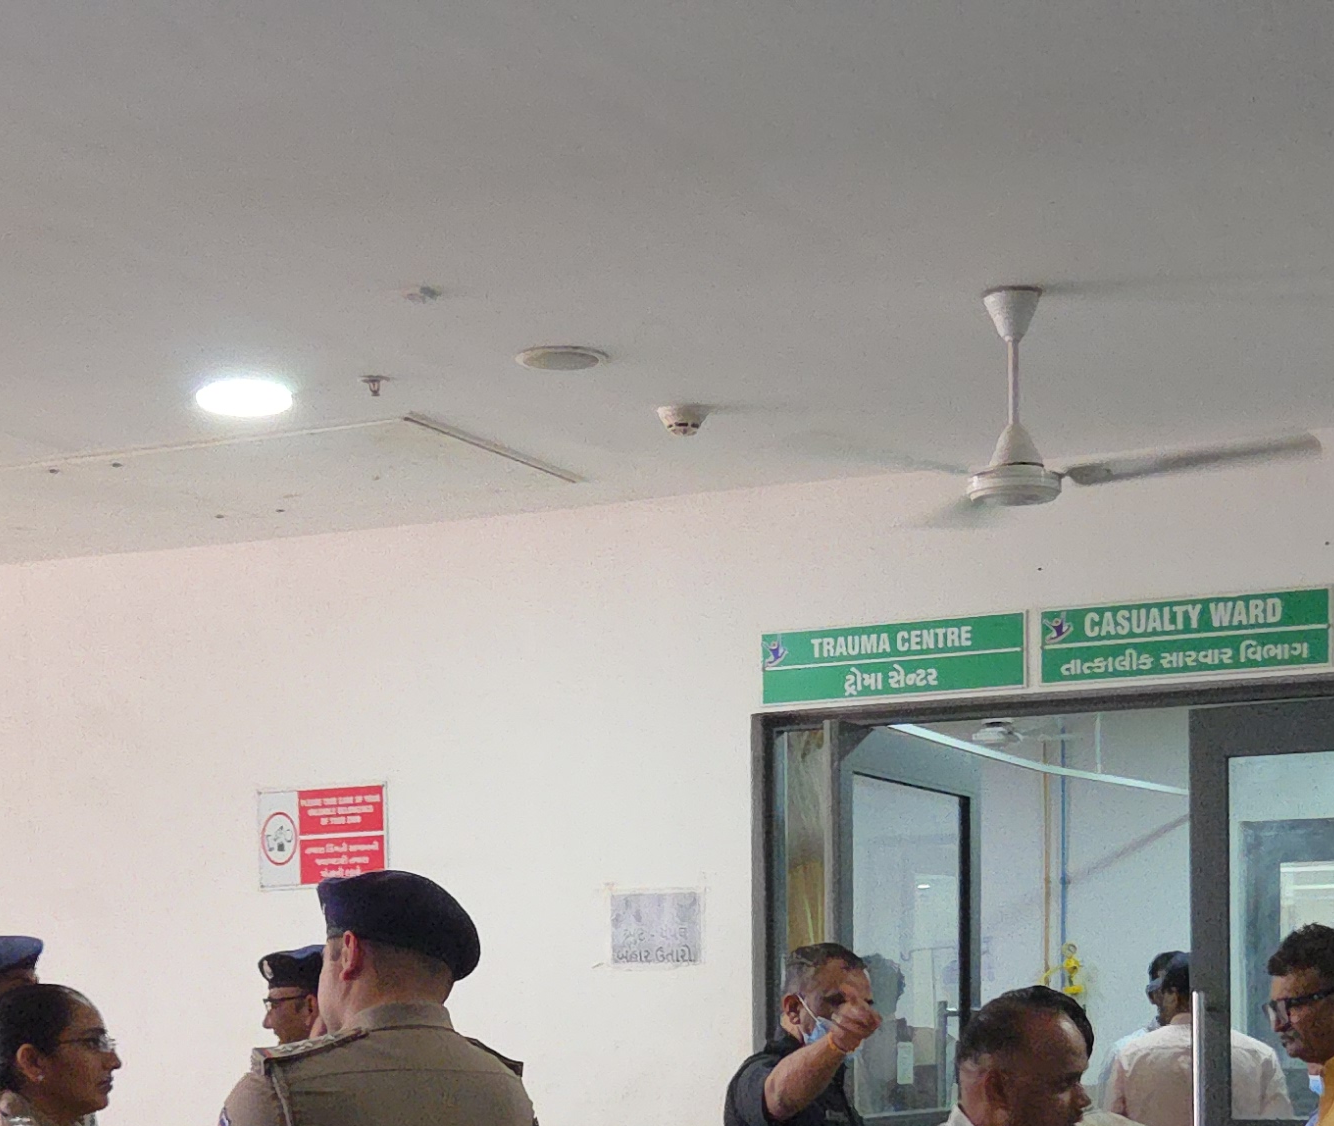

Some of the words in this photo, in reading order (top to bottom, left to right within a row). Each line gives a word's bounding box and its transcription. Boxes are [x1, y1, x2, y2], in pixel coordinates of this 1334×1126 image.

[1084, 604, 1201, 637] CASUALTY
[1209, 597, 1283, 627] WARD
[811, 633, 890, 657] TRAUMA
[896, 626, 972, 651] CENTRE
[1160, 646, 1233, 669] સારવાર
[1239, 640, 1309, 663] વિભાગ
[844, 667, 882, 696] ટ્રોમા
[888, 664, 938, 689] સેન્ટર
